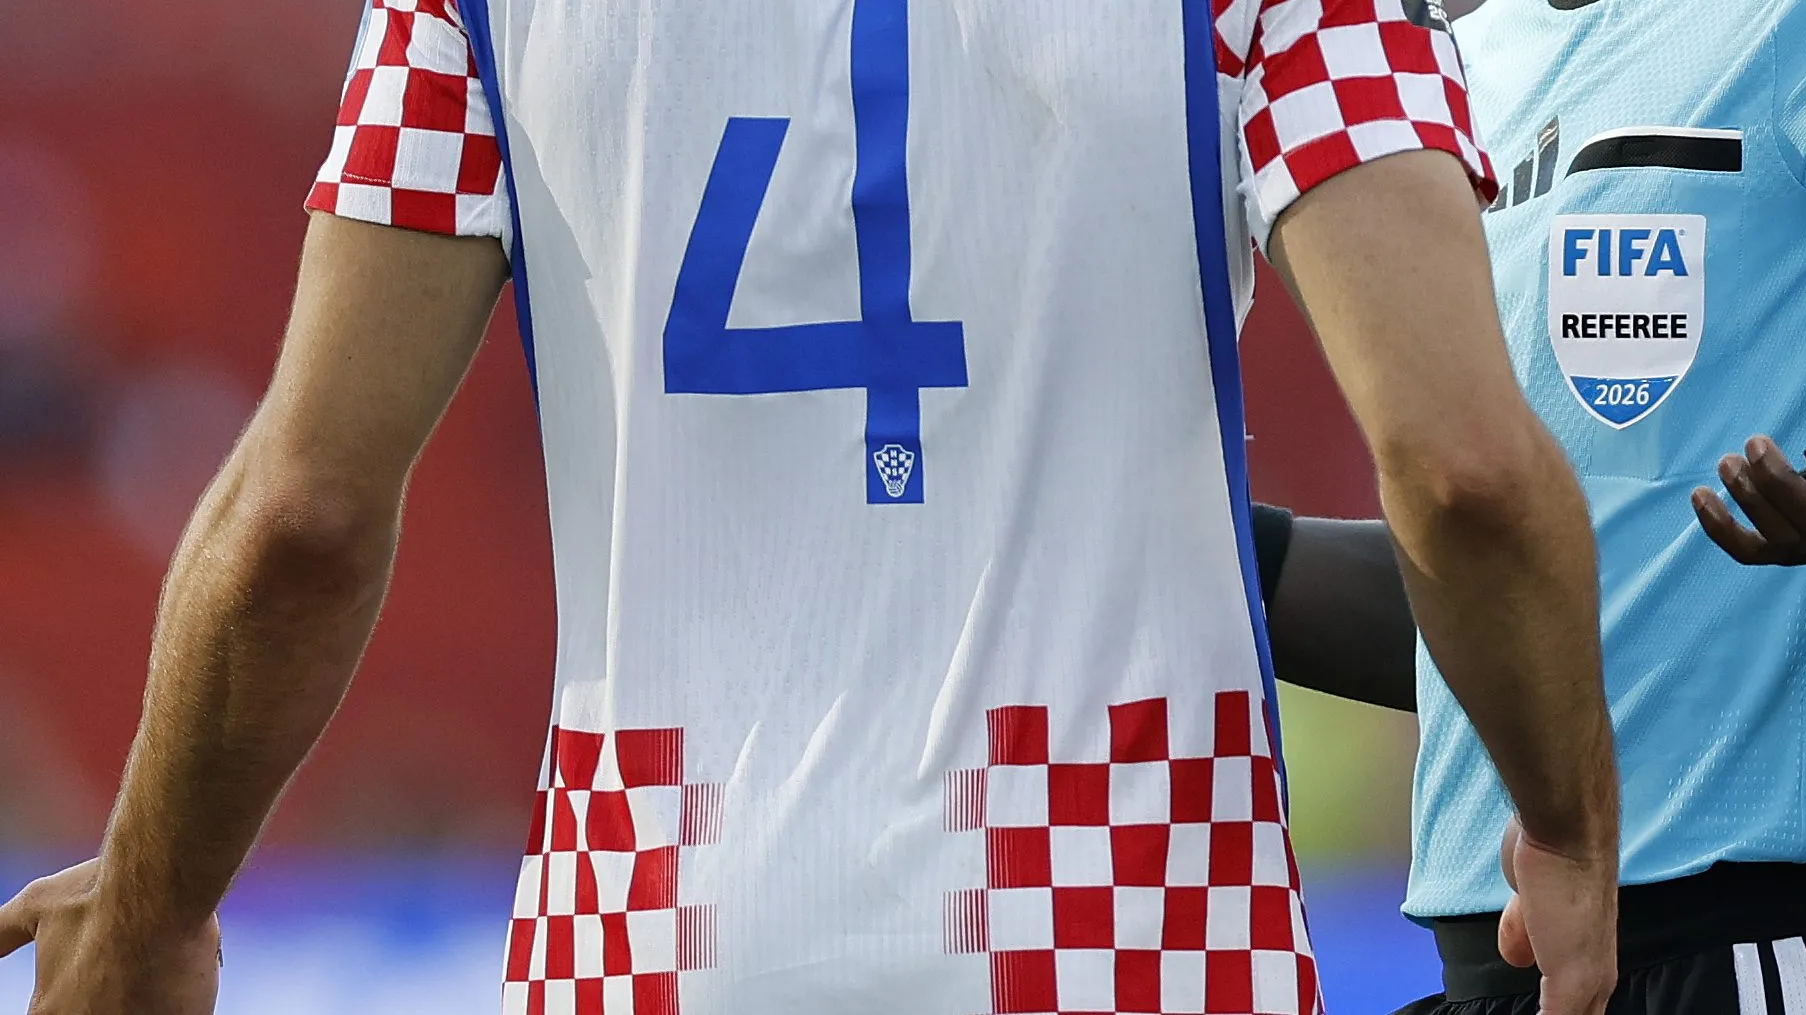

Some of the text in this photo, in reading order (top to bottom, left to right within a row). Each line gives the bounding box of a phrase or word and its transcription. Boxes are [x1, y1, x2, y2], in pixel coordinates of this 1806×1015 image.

[1563, 228, 1689, 277] FIFA
[1561, 313, 1688, 339] REFEREE
[1594, 383, 1650, 405] 2026
